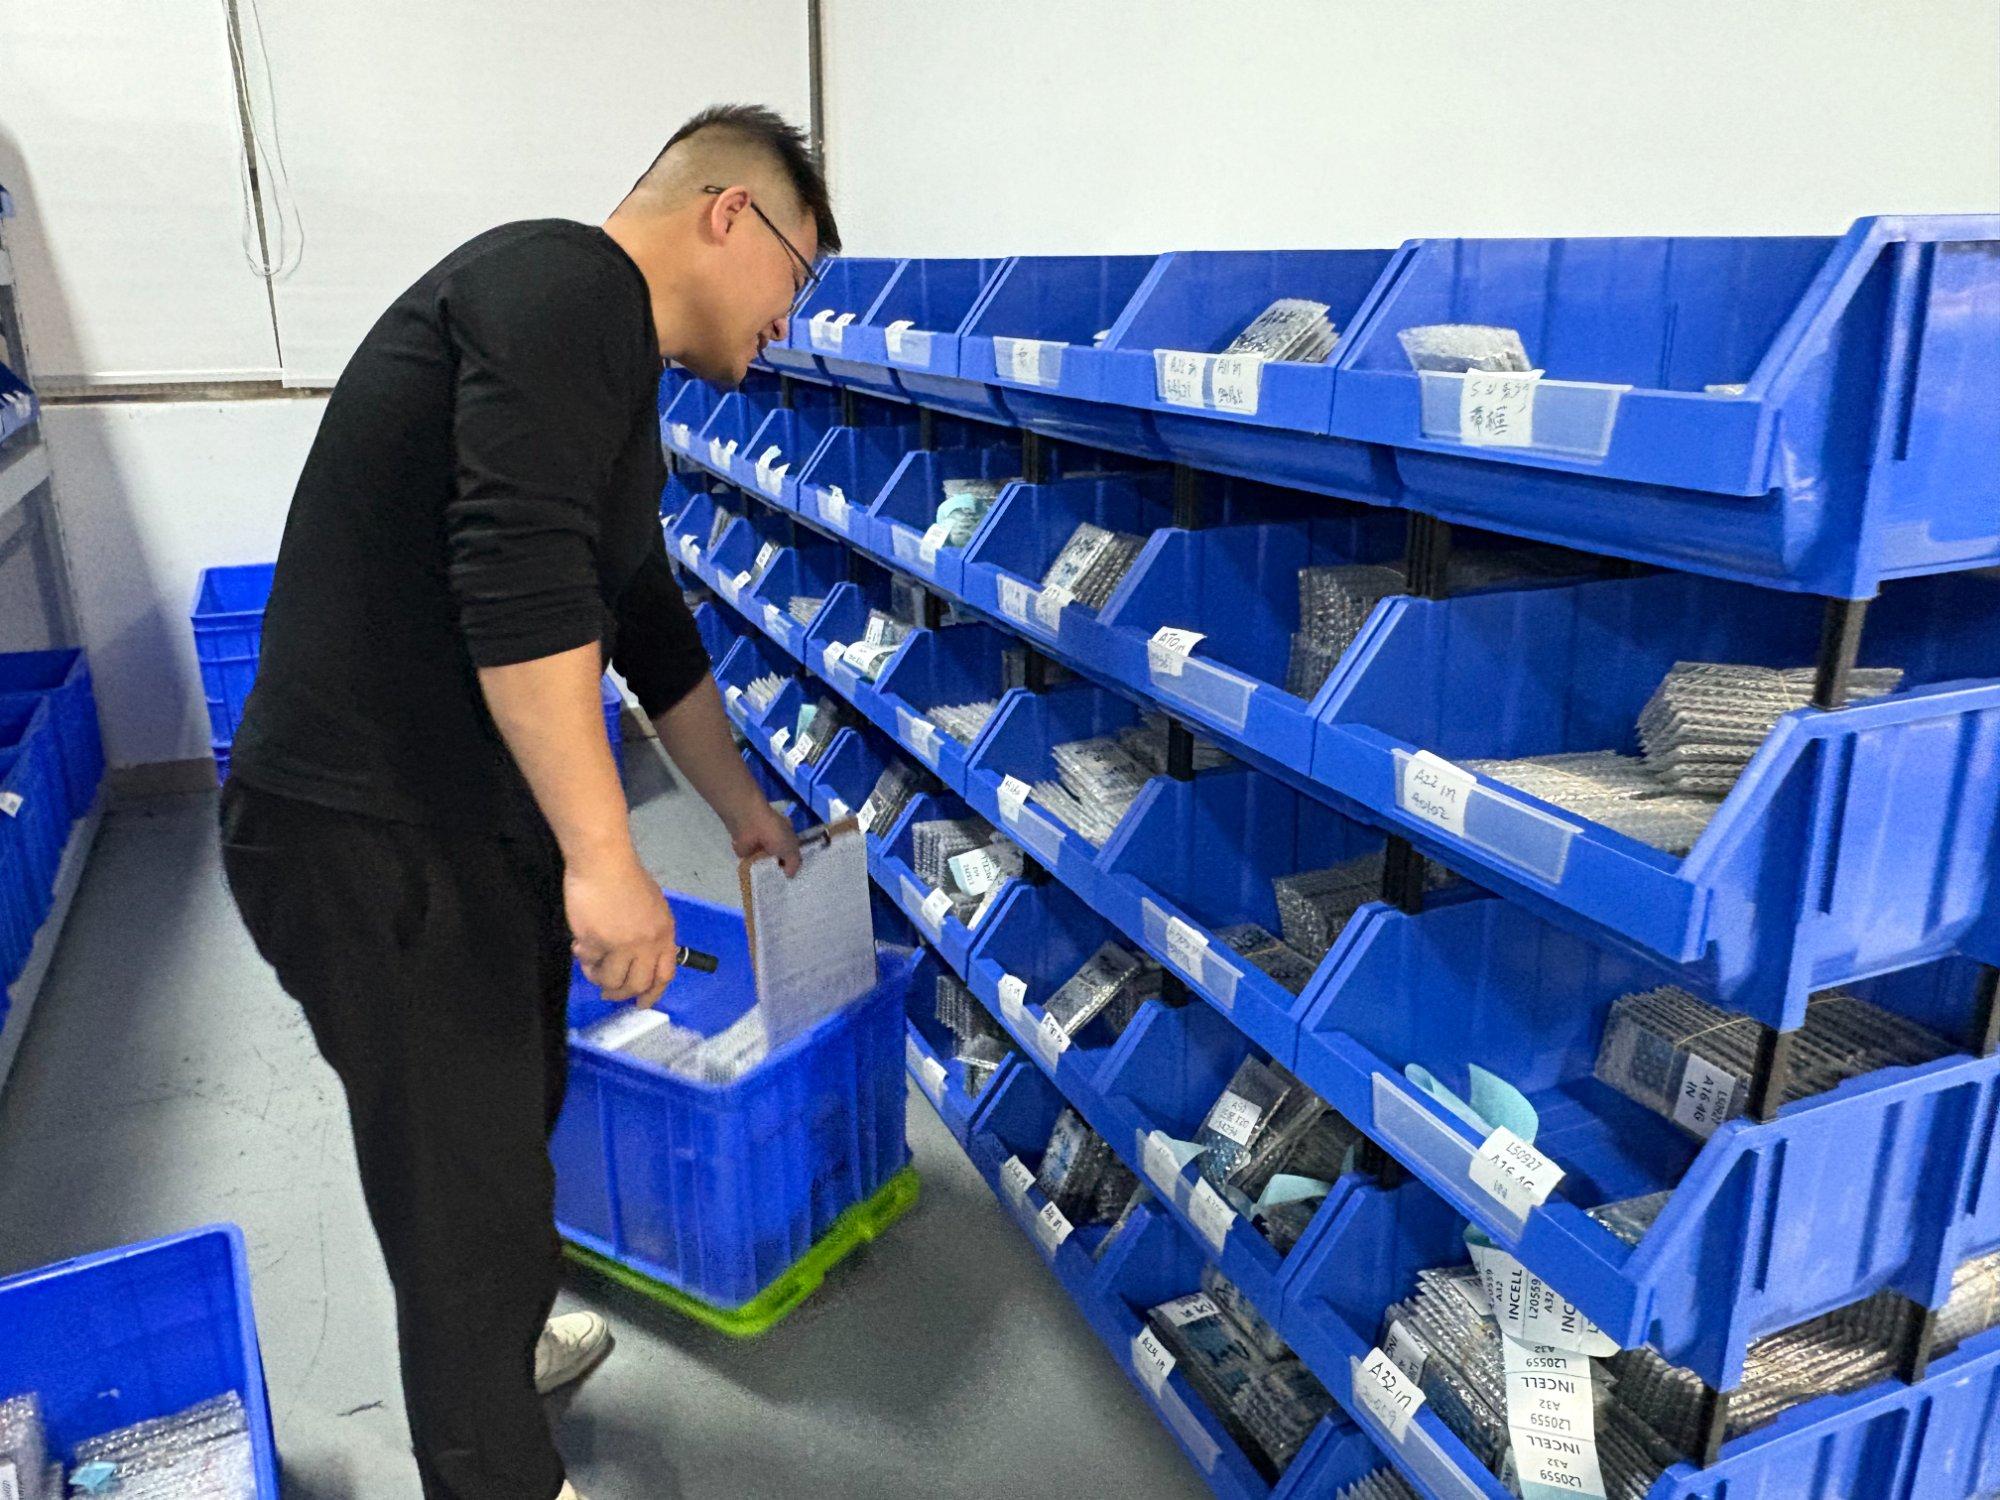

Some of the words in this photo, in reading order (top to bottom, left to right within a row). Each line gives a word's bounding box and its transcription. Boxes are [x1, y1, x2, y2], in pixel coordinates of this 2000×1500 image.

[1508, 1268, 1523, 1321] INCELL
[1528, 1278, 1542, 1320] L20559
[1543, 1290, 1556, 1314] A32
[1525, 1357, 1568, 1370] L20559
[1368, 1361, 1397, 1394] A32
[1520, 1376, 1576, 1394] INCELL
[1538, 1398, 1561, 1412] A32
[1530, 1413, 1572, 1431] L20559
[1526, 1434, 1581, 1456] INCELL
[1546, 1457, 1569, 1469] A32
[1540, 1468, 1582, 1489] L20559
